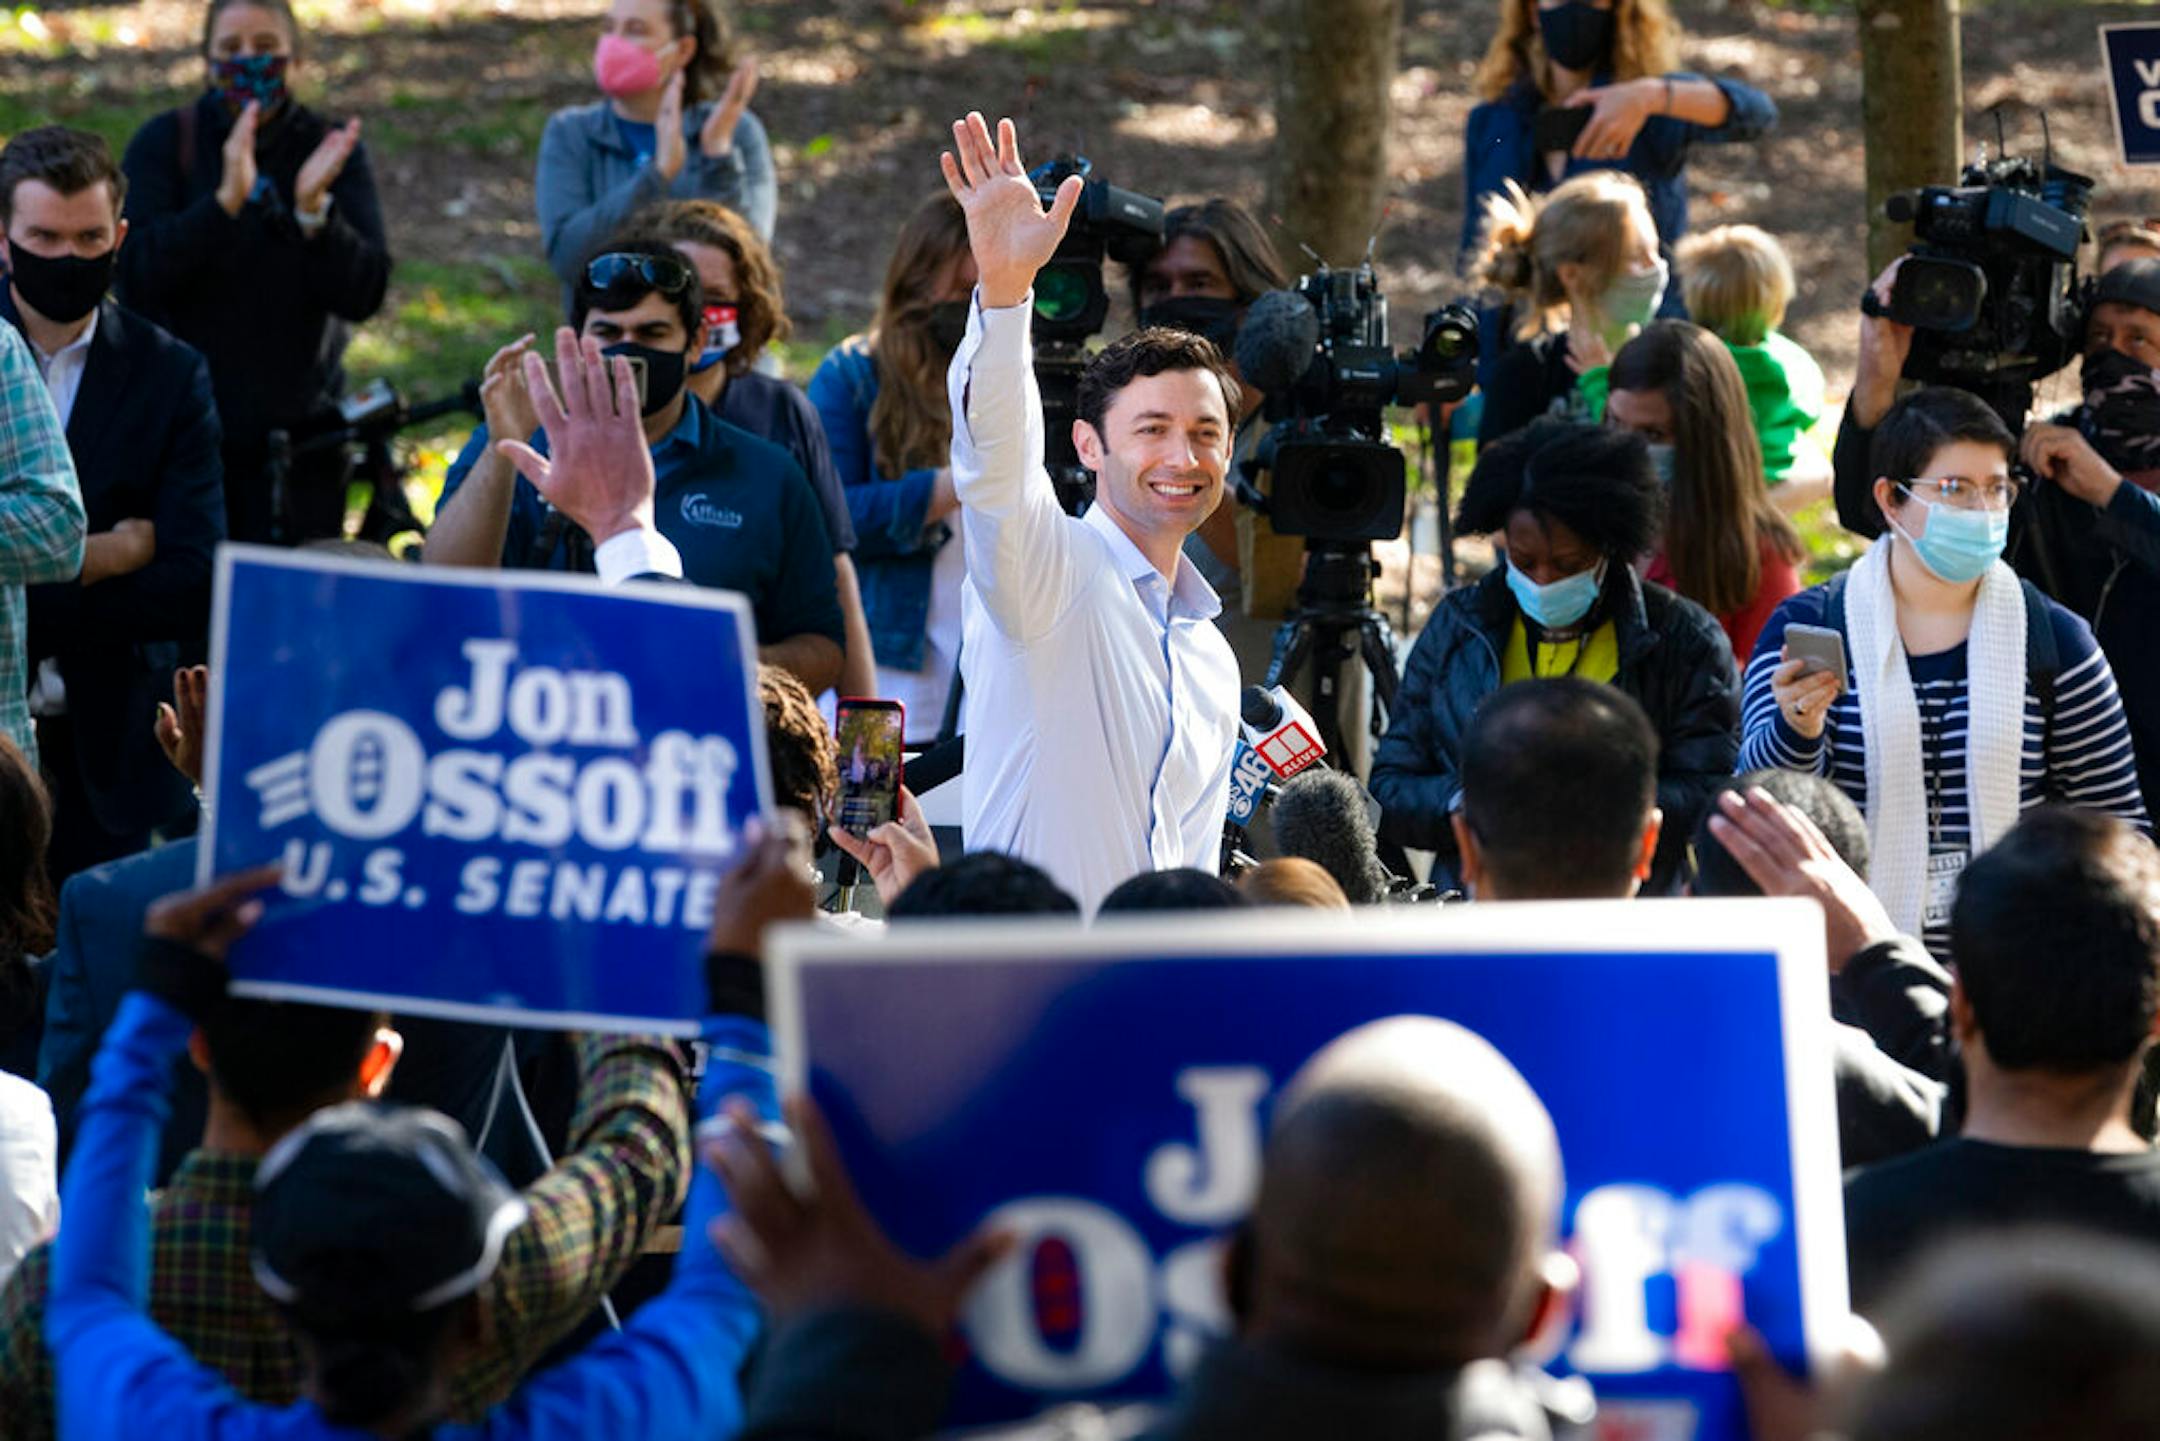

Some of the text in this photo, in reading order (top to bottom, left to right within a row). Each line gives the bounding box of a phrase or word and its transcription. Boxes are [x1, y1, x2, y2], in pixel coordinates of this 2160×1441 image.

[434, 638, 638, 748] Jon
[308, 709, 738, 856] Ossoff
[1233, 750, 1272, 797] 46
[1281, 748, 1321, 776] ALIVE
[281, 838, 718, 930] U.S. SENATE
